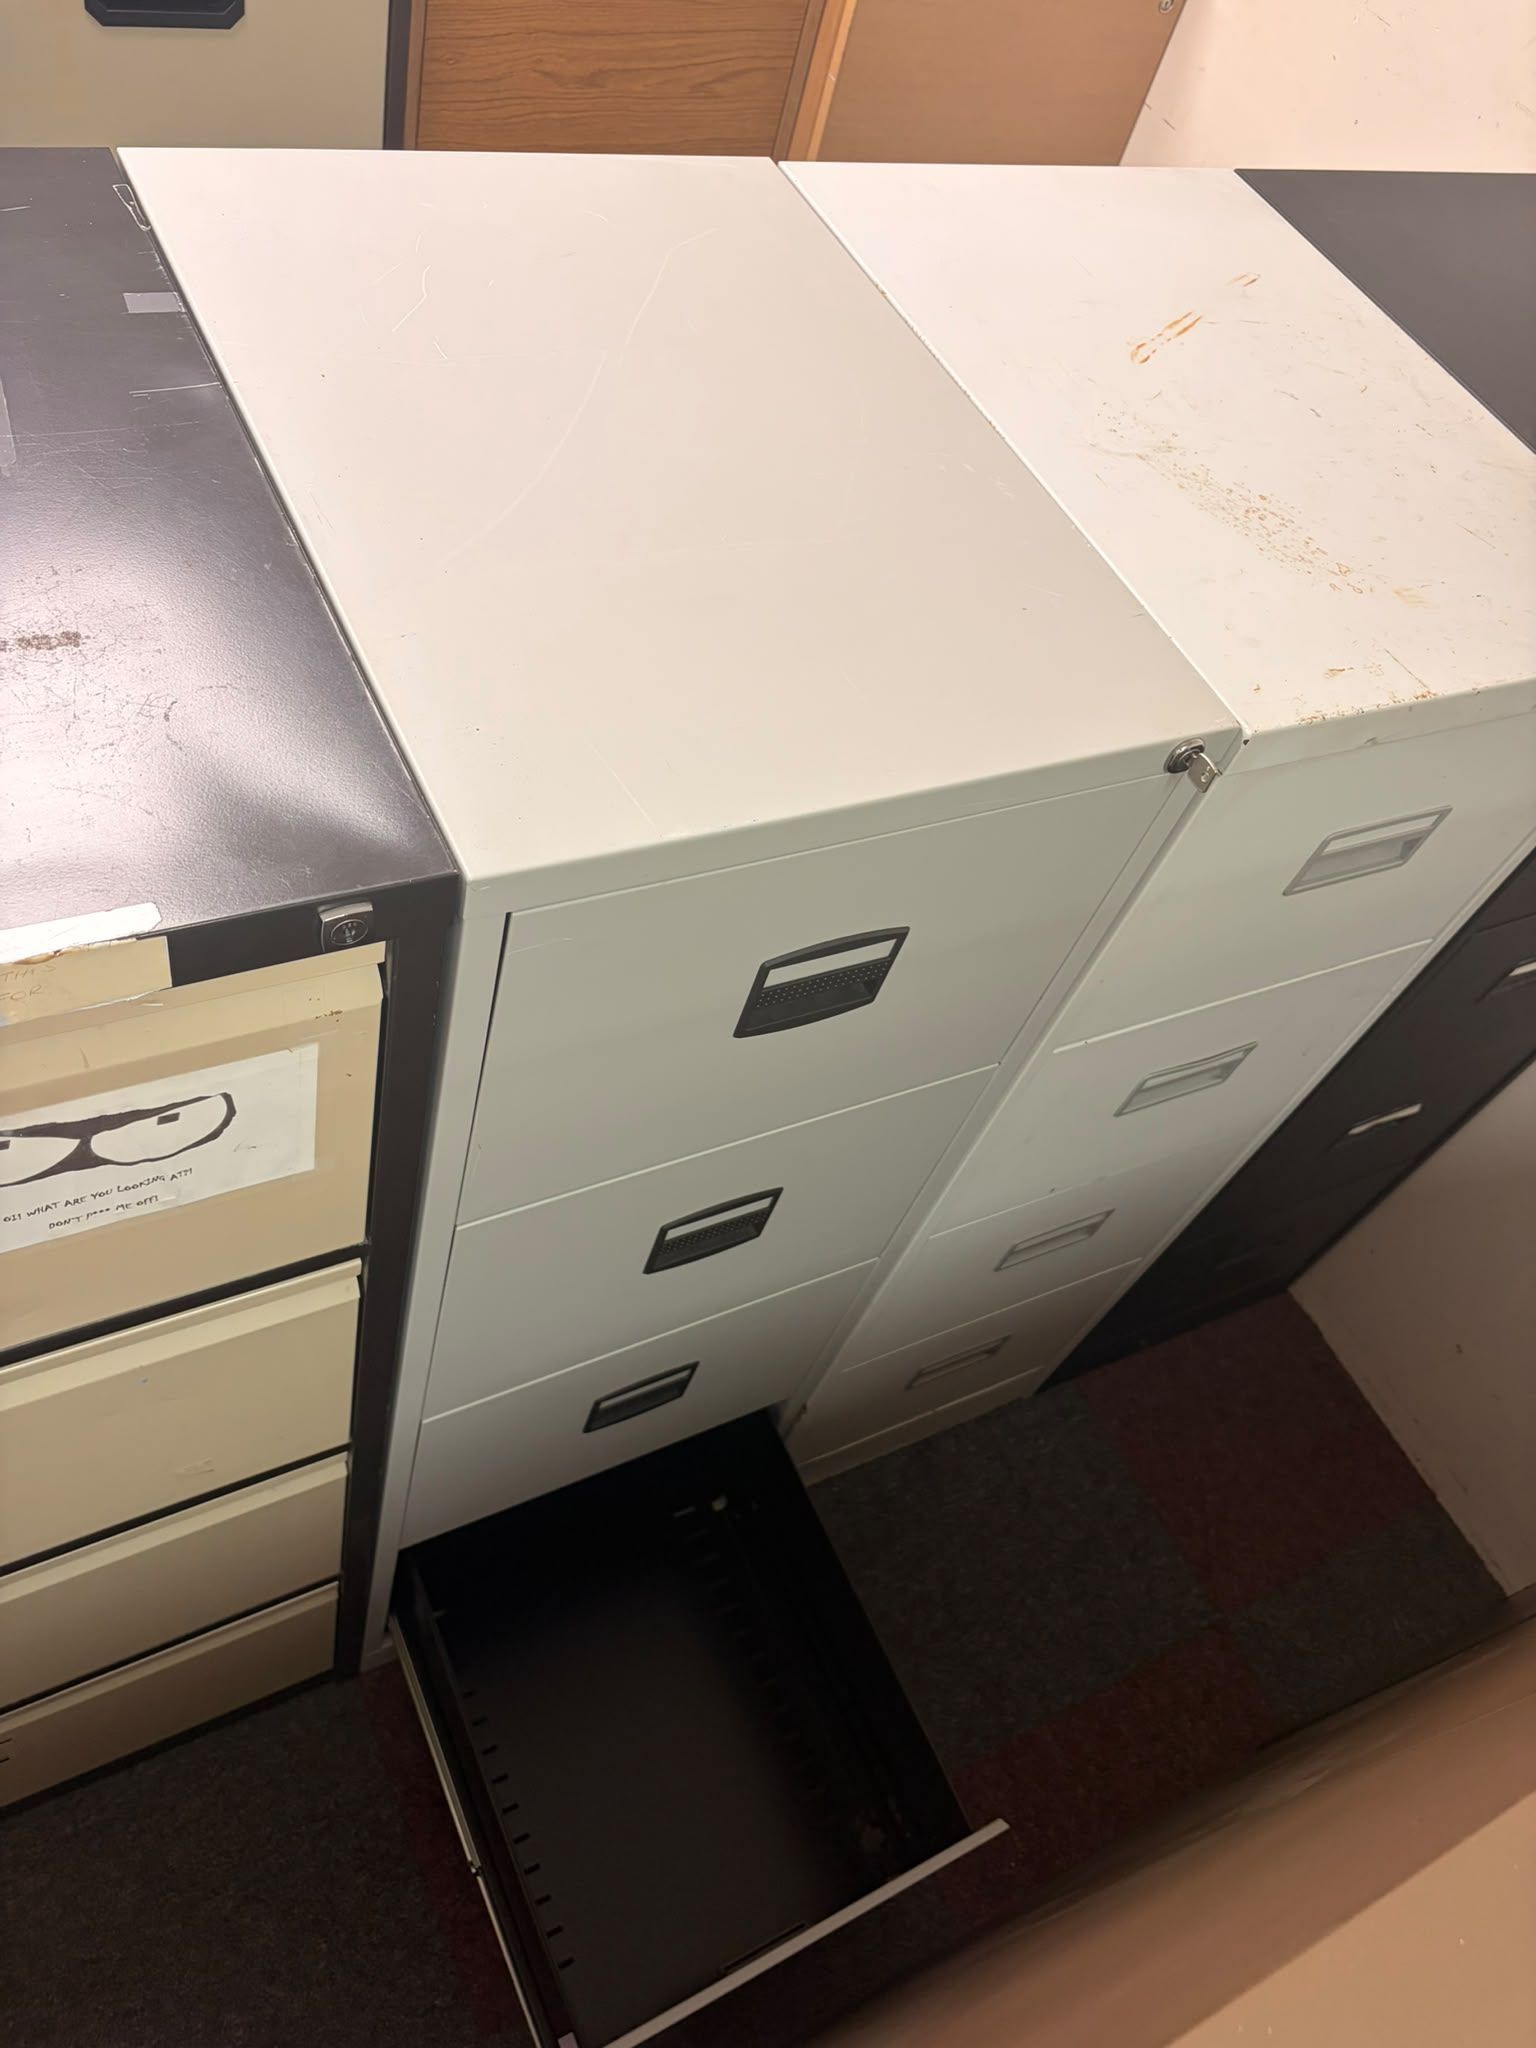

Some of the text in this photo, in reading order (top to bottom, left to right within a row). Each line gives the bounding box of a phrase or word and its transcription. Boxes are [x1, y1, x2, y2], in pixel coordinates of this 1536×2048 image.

[26, 1201, 61, 1217] WHAT
[64, 1195, 87, 1207] ARE
[90, 1188, 113, 1200] YOU
[117, 1175, 165, 1192] LOOKING
[48, 1215, 83, 1230] DON'T
[115, 1202, 133, 1211] ME
